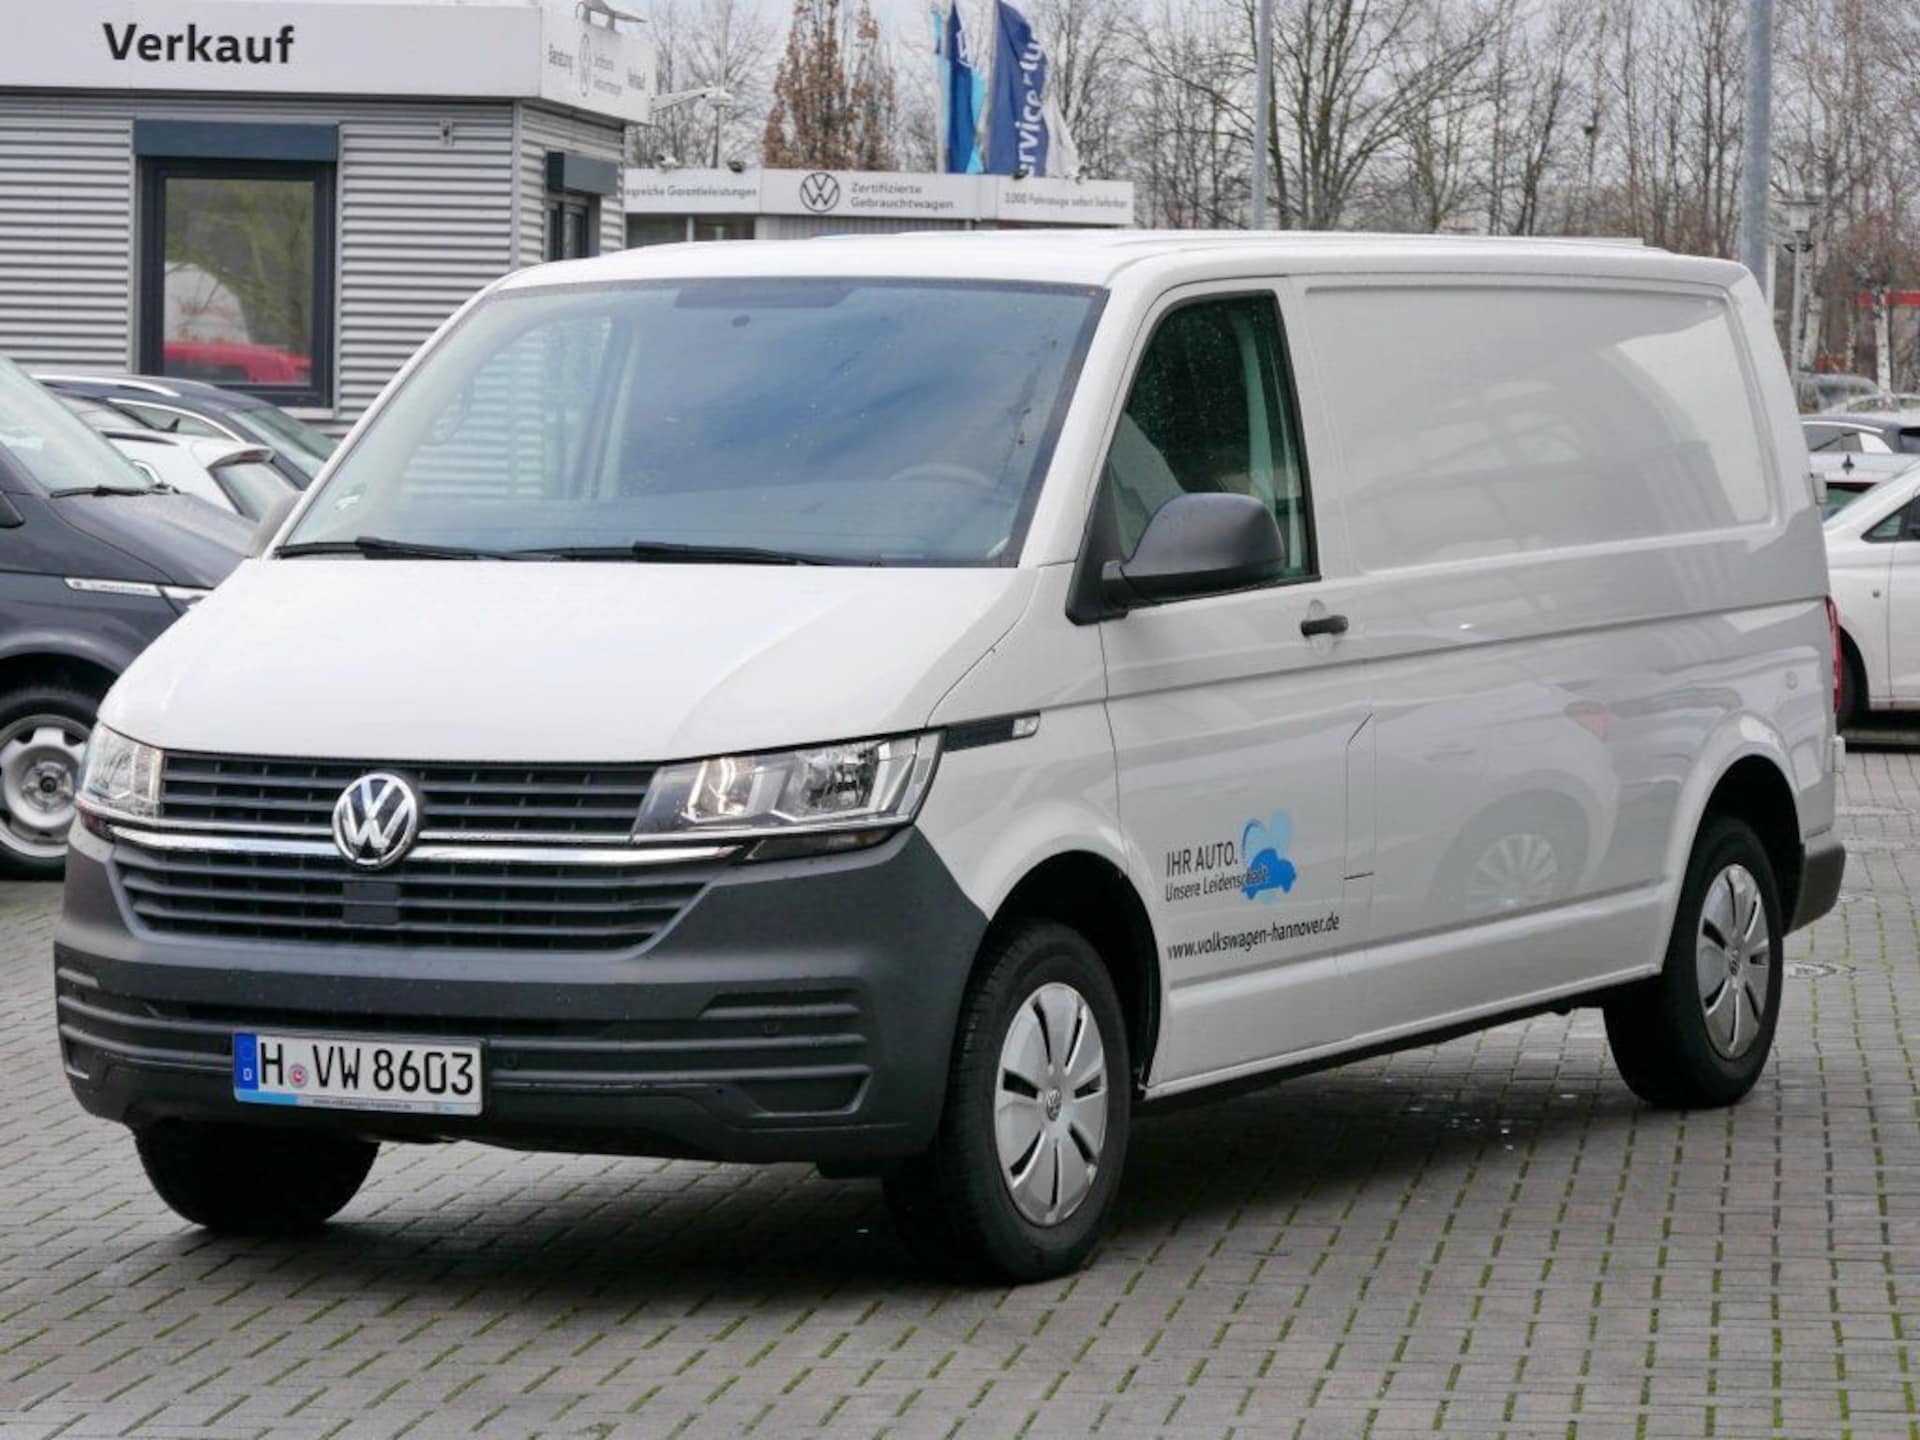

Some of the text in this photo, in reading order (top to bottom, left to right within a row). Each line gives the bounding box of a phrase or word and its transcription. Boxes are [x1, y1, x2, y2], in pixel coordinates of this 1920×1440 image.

[102, 22, 295, 64] Verkauf
[850, 182, 922, 195] Zertifizierte
[850, 196, 954, 211] Gebrauchtwagen
[1166, 840, 1239, 878] IHR AUTO.
[1165, 882, 1202, 902] Unsere
[1167, 912, 1340, 960] www.volkswagen-hannover.de
[260, 1042, 474, 1096] H VW 8603
